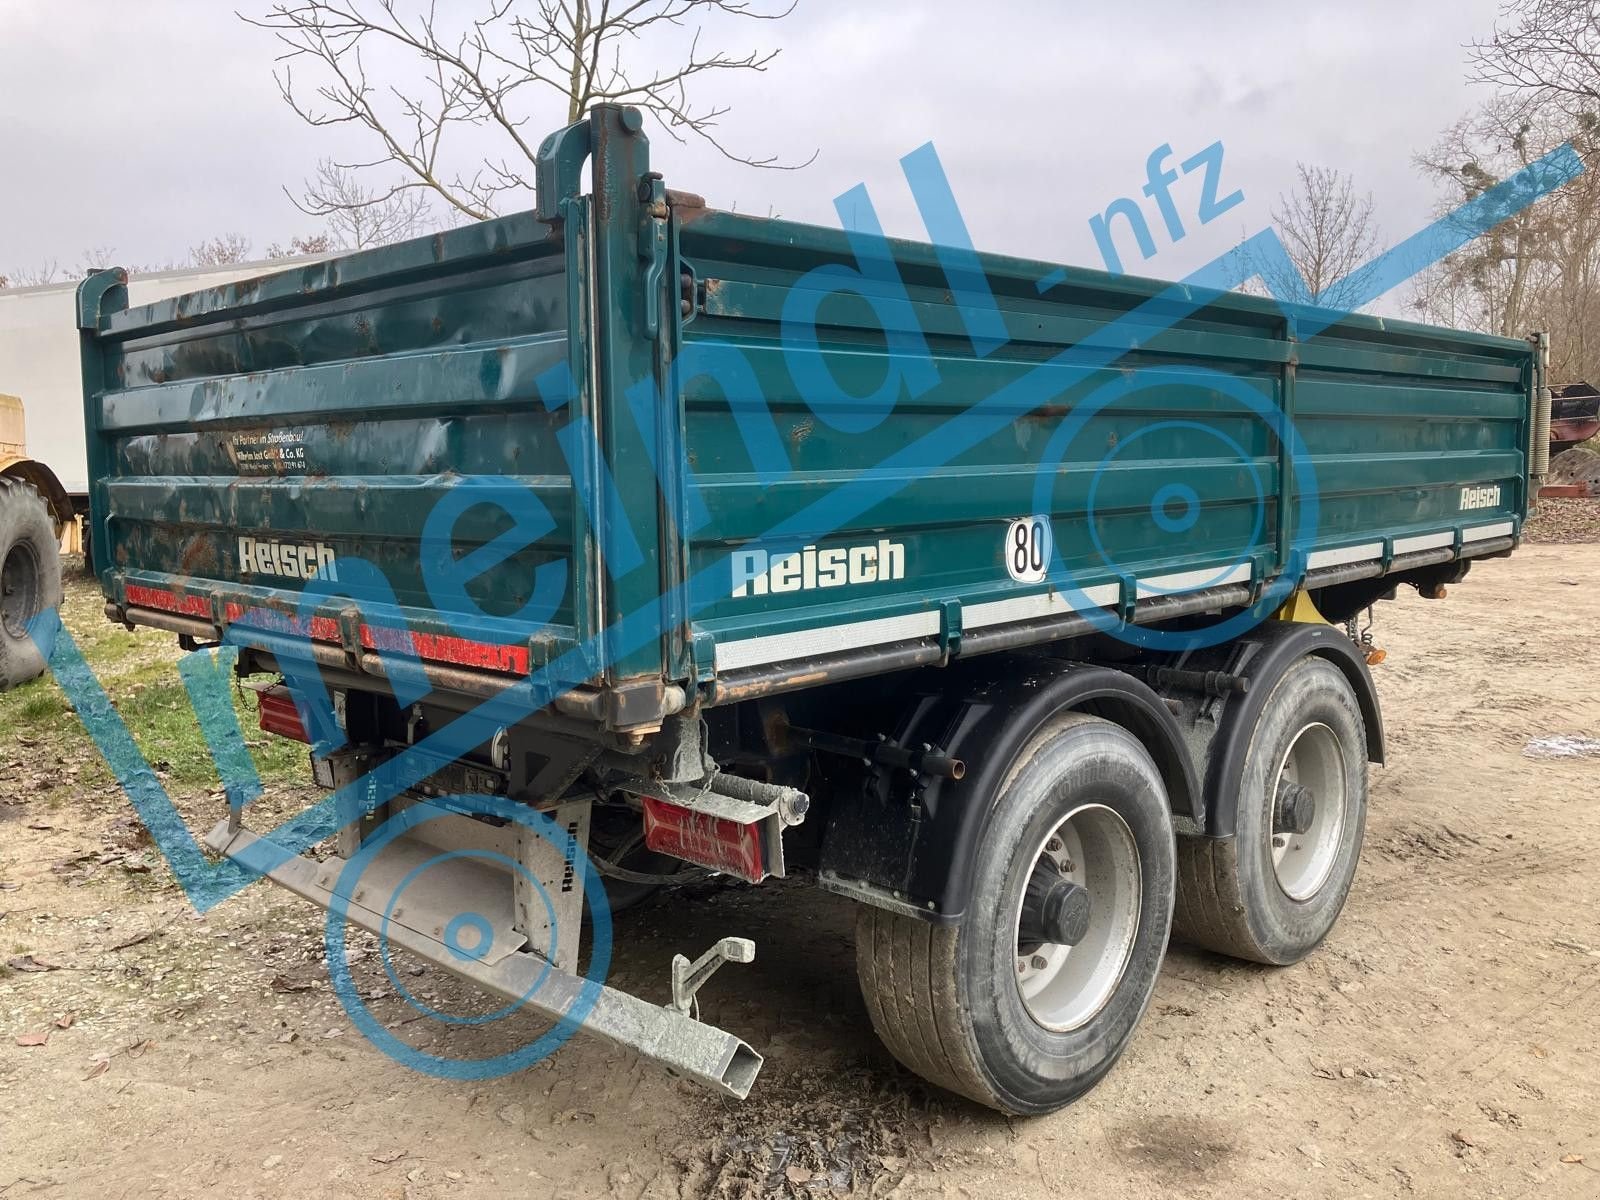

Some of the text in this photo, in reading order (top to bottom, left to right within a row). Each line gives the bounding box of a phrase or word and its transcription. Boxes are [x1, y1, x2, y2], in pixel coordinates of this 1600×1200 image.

[280, 446, 285, 459] &
[286, 448, 296, 459] Co.
[295, 446, 304, 458] KG
[1459, 485, 1501, 510] Reisch
[238, 536, 339, 582] Reisch
[731, 539, 905, 598] Reisch
[1014, 522, 1044, 574] 80
[562, 822, 578, 892] Reisch
